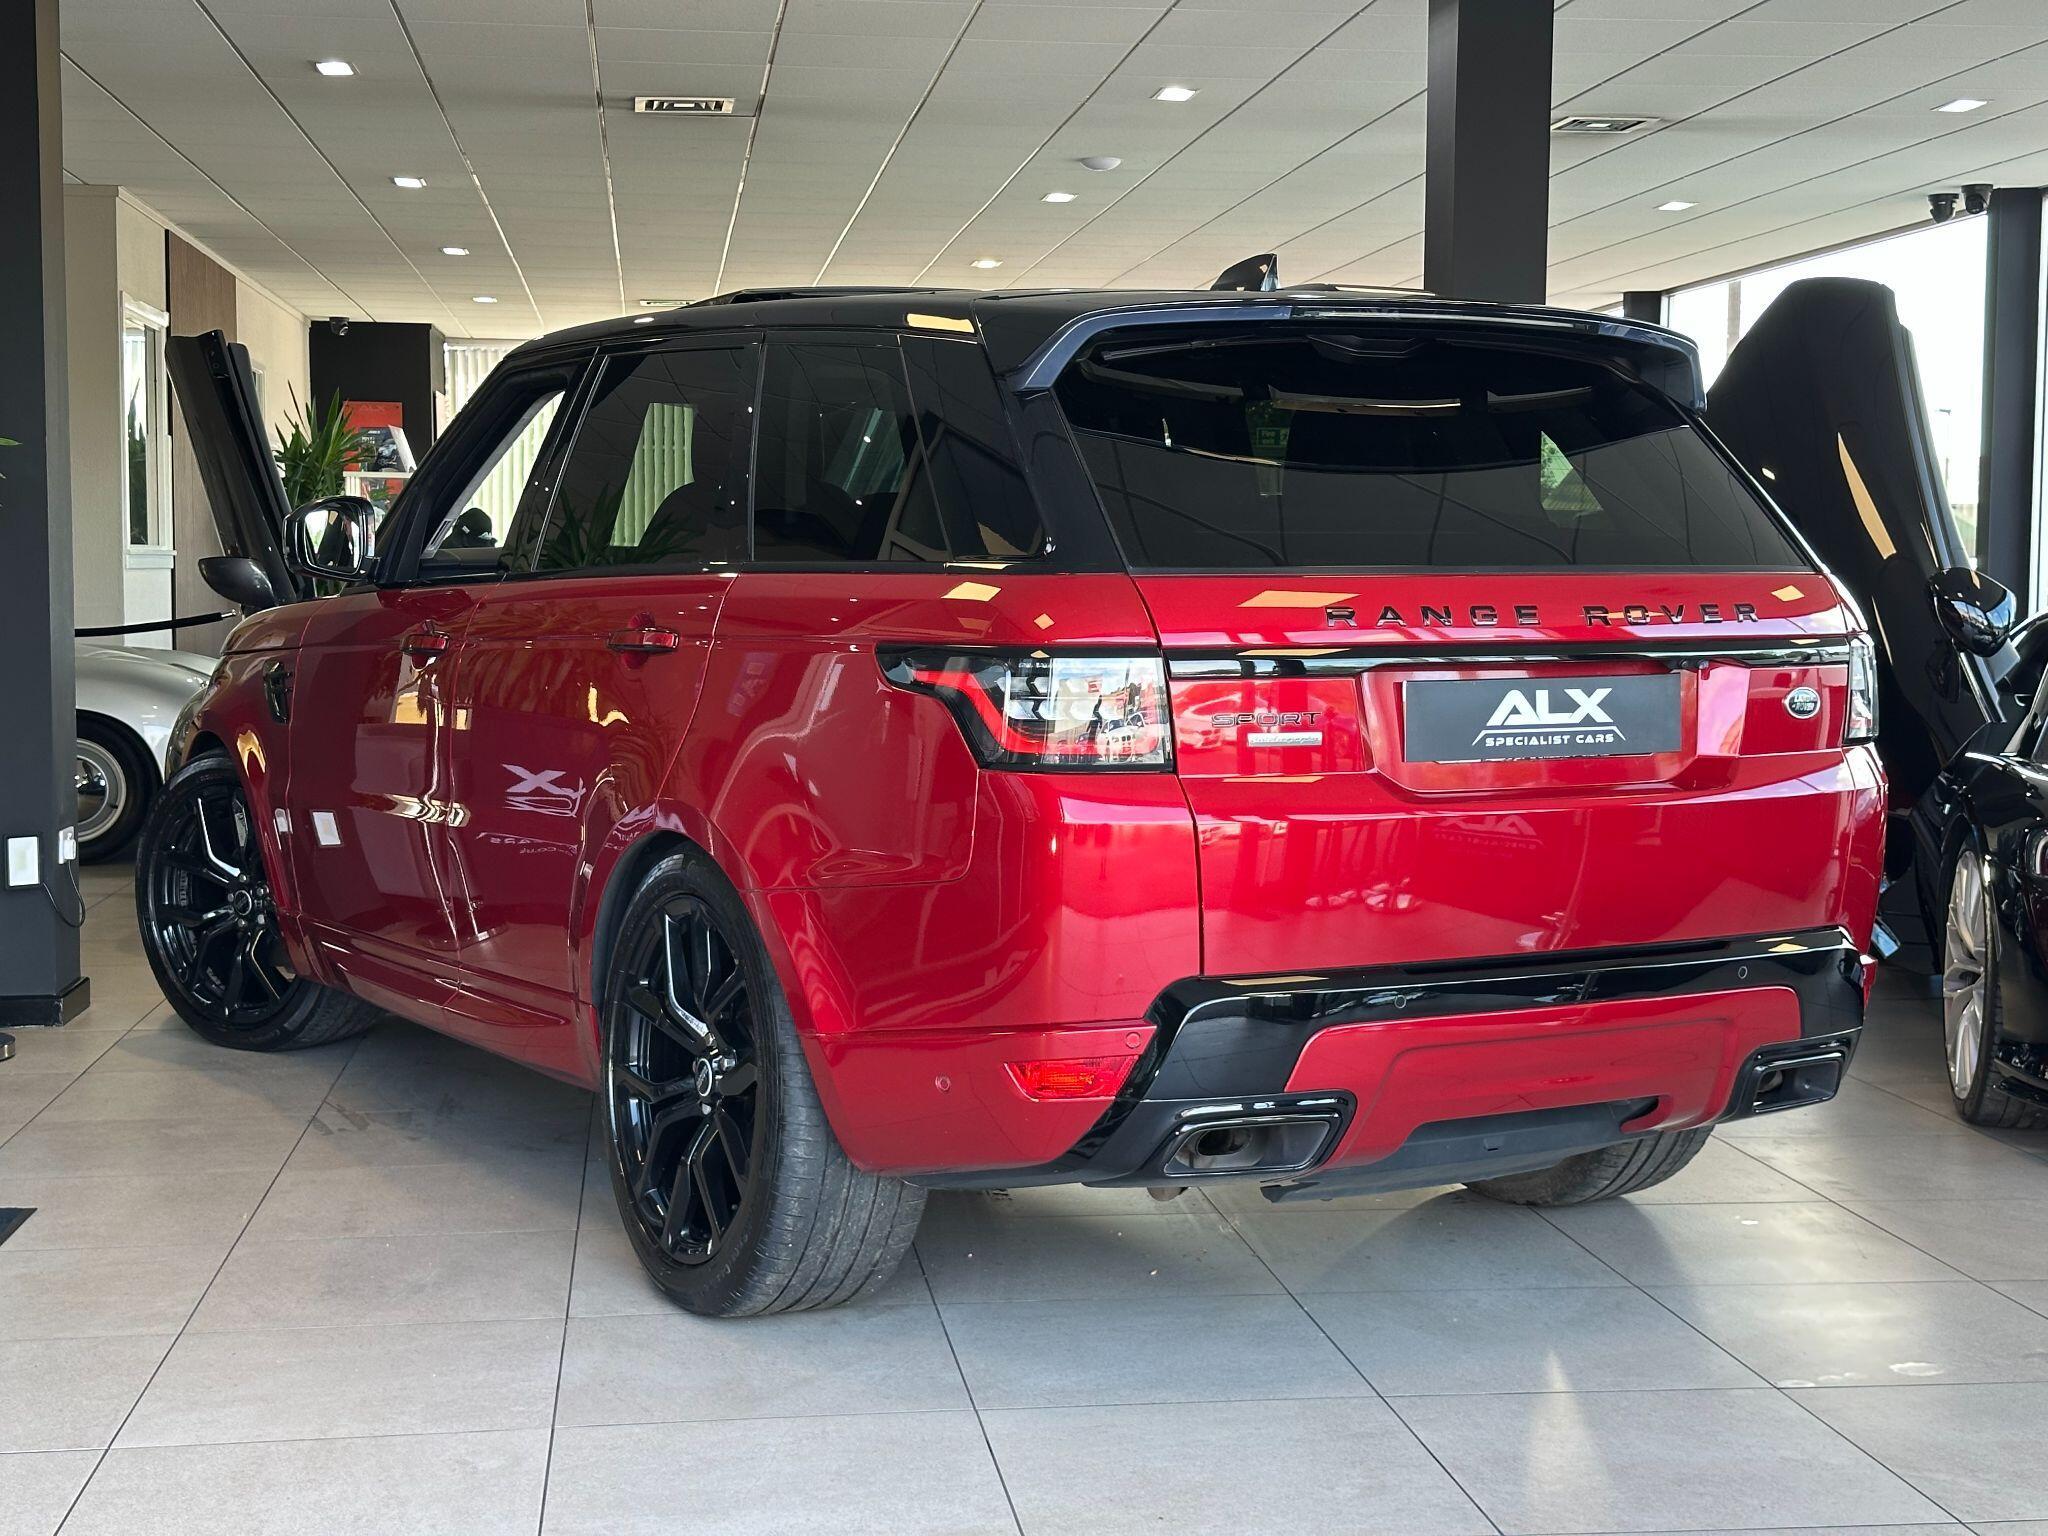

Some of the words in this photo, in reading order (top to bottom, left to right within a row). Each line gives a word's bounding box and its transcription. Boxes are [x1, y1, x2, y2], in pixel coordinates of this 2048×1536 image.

[1325, 605, 1540, 627] RANGE
[1583, 603, 1759, 626] ROVER
[1486, 687, 1613, 726] ALX
[1212, 712, 1322, 728] SPORT
[1485, 735, 1571, 747] SPECIALIST
[1575, 733, 1614, 744] CARS
